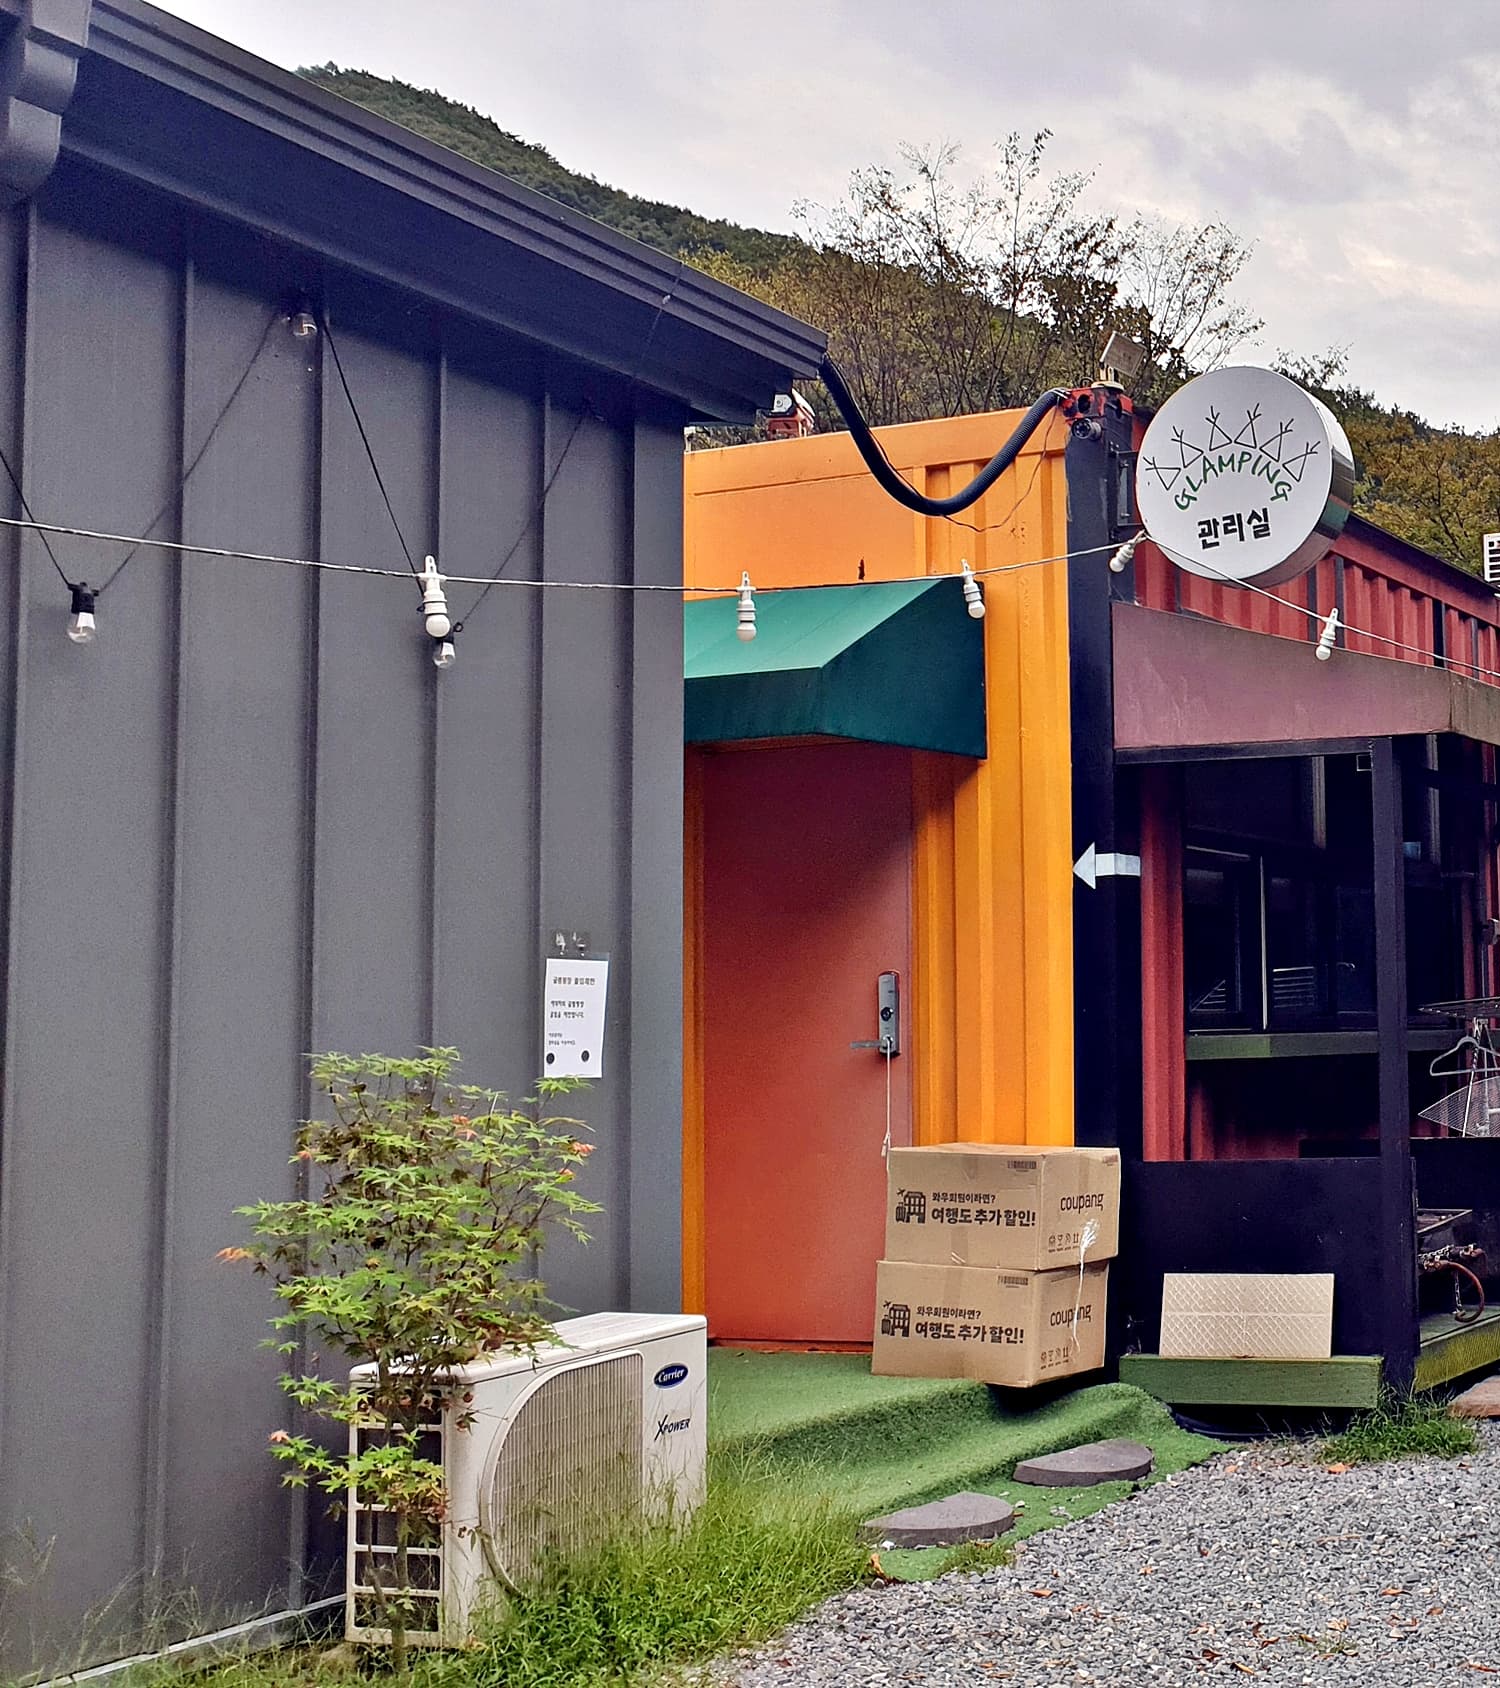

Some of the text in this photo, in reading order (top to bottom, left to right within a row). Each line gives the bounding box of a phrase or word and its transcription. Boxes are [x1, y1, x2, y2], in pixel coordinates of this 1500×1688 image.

[1174, 451, 1292, 510] GLAMPING
[1197, 507, 1271, 549] 관리실
[932, 1192, 996, 1204] 와우회원이라면?
[1060, 1193, 1104, 1214] coupang
[931, 1207, 1036, 1227] 여행도 추가 할인!
[916, 1306, 981, 1319] 와우회원이라면?
[915, 1321, 1024, 1344] 여행도 추가 할인!
[657, 1367, 685, 1383] Carrier
[654, 1414, 691, 1441] XPOWER
